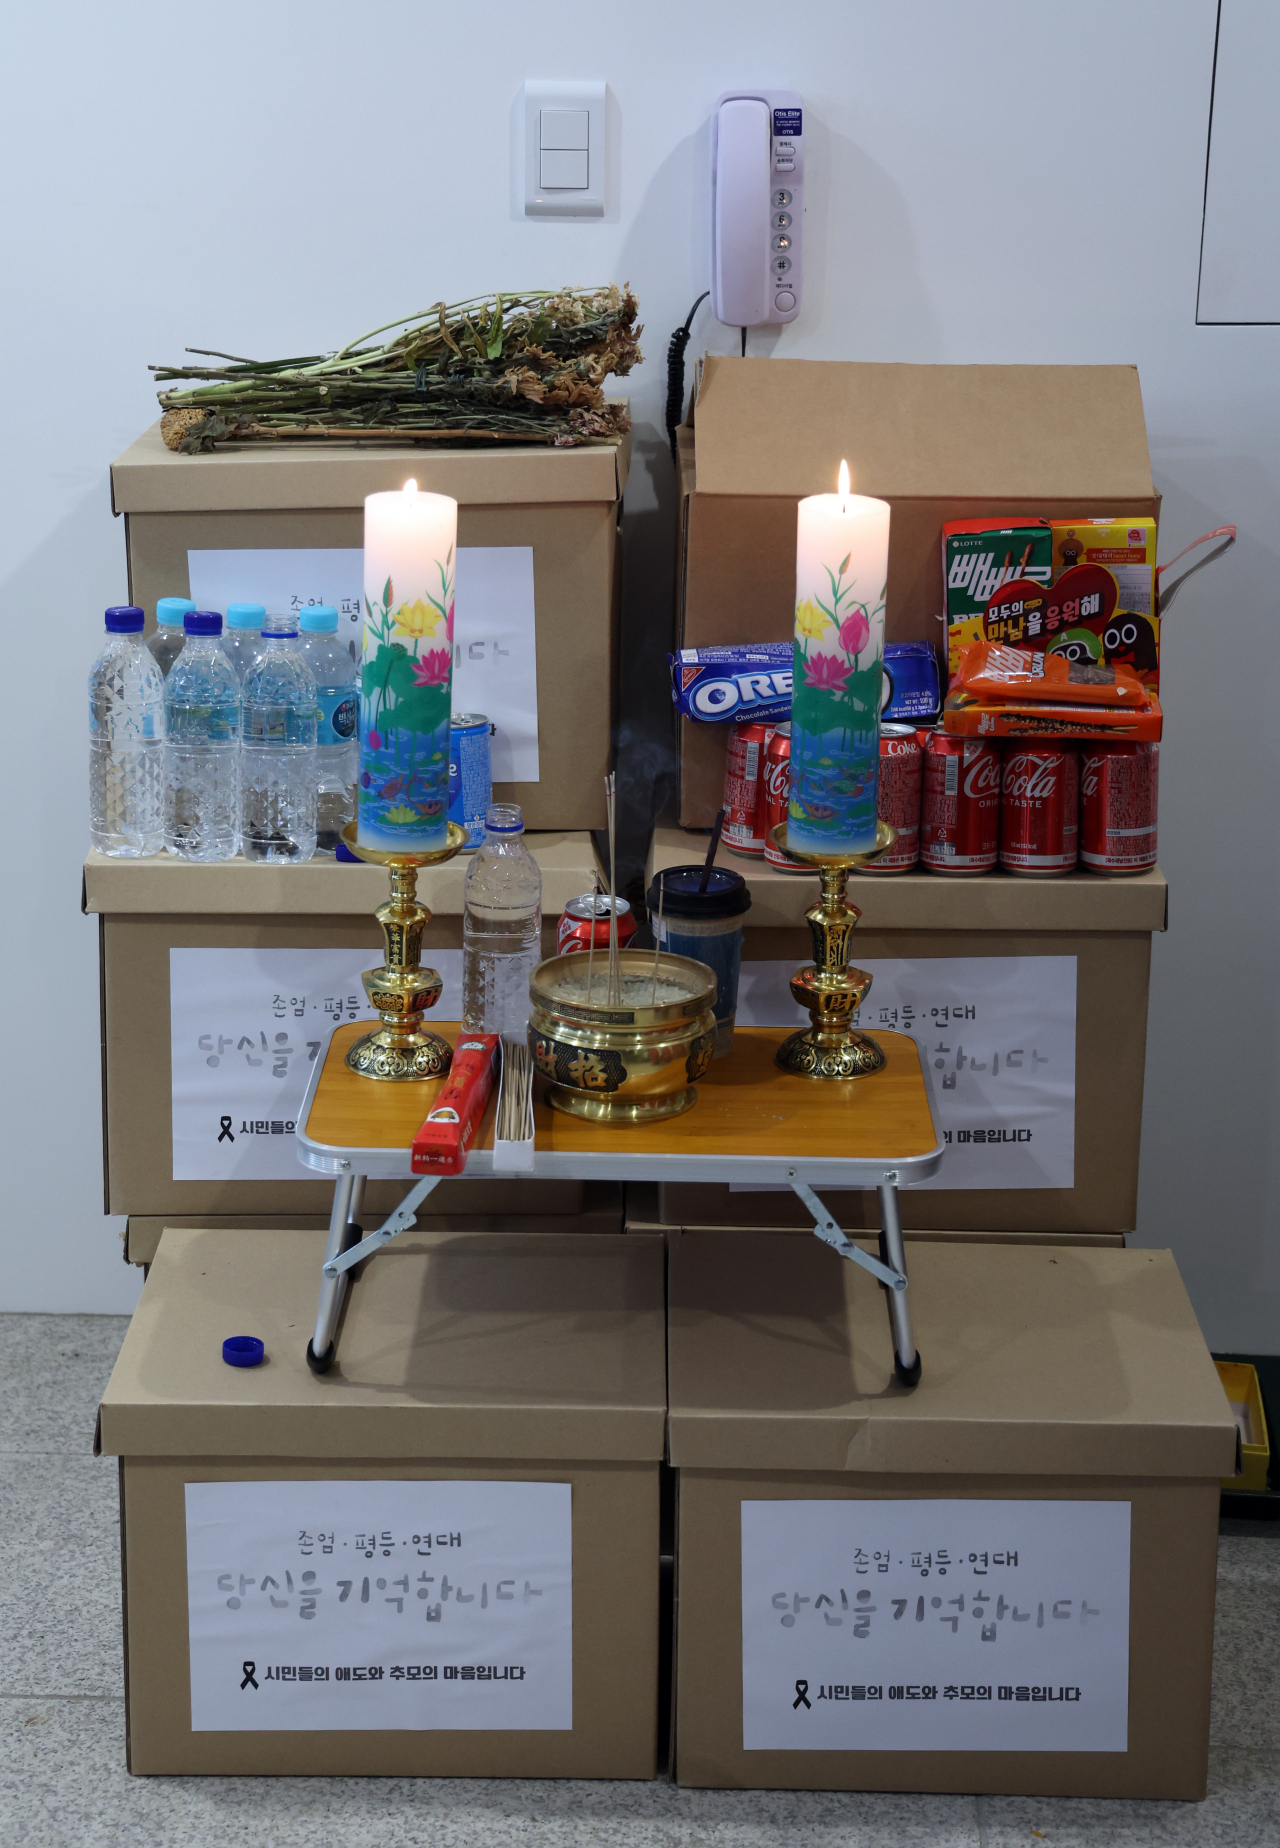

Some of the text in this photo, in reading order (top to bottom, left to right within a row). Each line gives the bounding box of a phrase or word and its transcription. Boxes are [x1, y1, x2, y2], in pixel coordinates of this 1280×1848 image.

[779, 192, 785, 202] 3
[779, 215, 785, 224] 6
[987, 600, 1024, 623] 모두의
[987, 592, 1100, 644] 만남을 응원해
[1060, 632, 1068, 642] A
[1028, 651, 1046, 678] CRUN
[695, 672, 793, 714] ORE
[735, 705, 792, 722] Chocolate Sandwic
[887, 740, 918, 756] Coke
[1010, 799, 1042, 808] TASTE
[198, 1030, 294, 1078] 당신을
[934, 1041, 1049, 1090] 합니다
[239, 1120, 297, 1135] 시민들의
[957, 1128, 1032, 1144] 마음입니다
[217, 1569, 543, 1623] 당신을 기억합니다
[771, 1588, 1101, 1642] 당신을 기억합니다
[264, 1665, 526, 1682] 시민들의 애도와 추모의 마음입니다
[816, 1684, 1082, 1702] 시민들의 애도와 추모의 마음입니다
